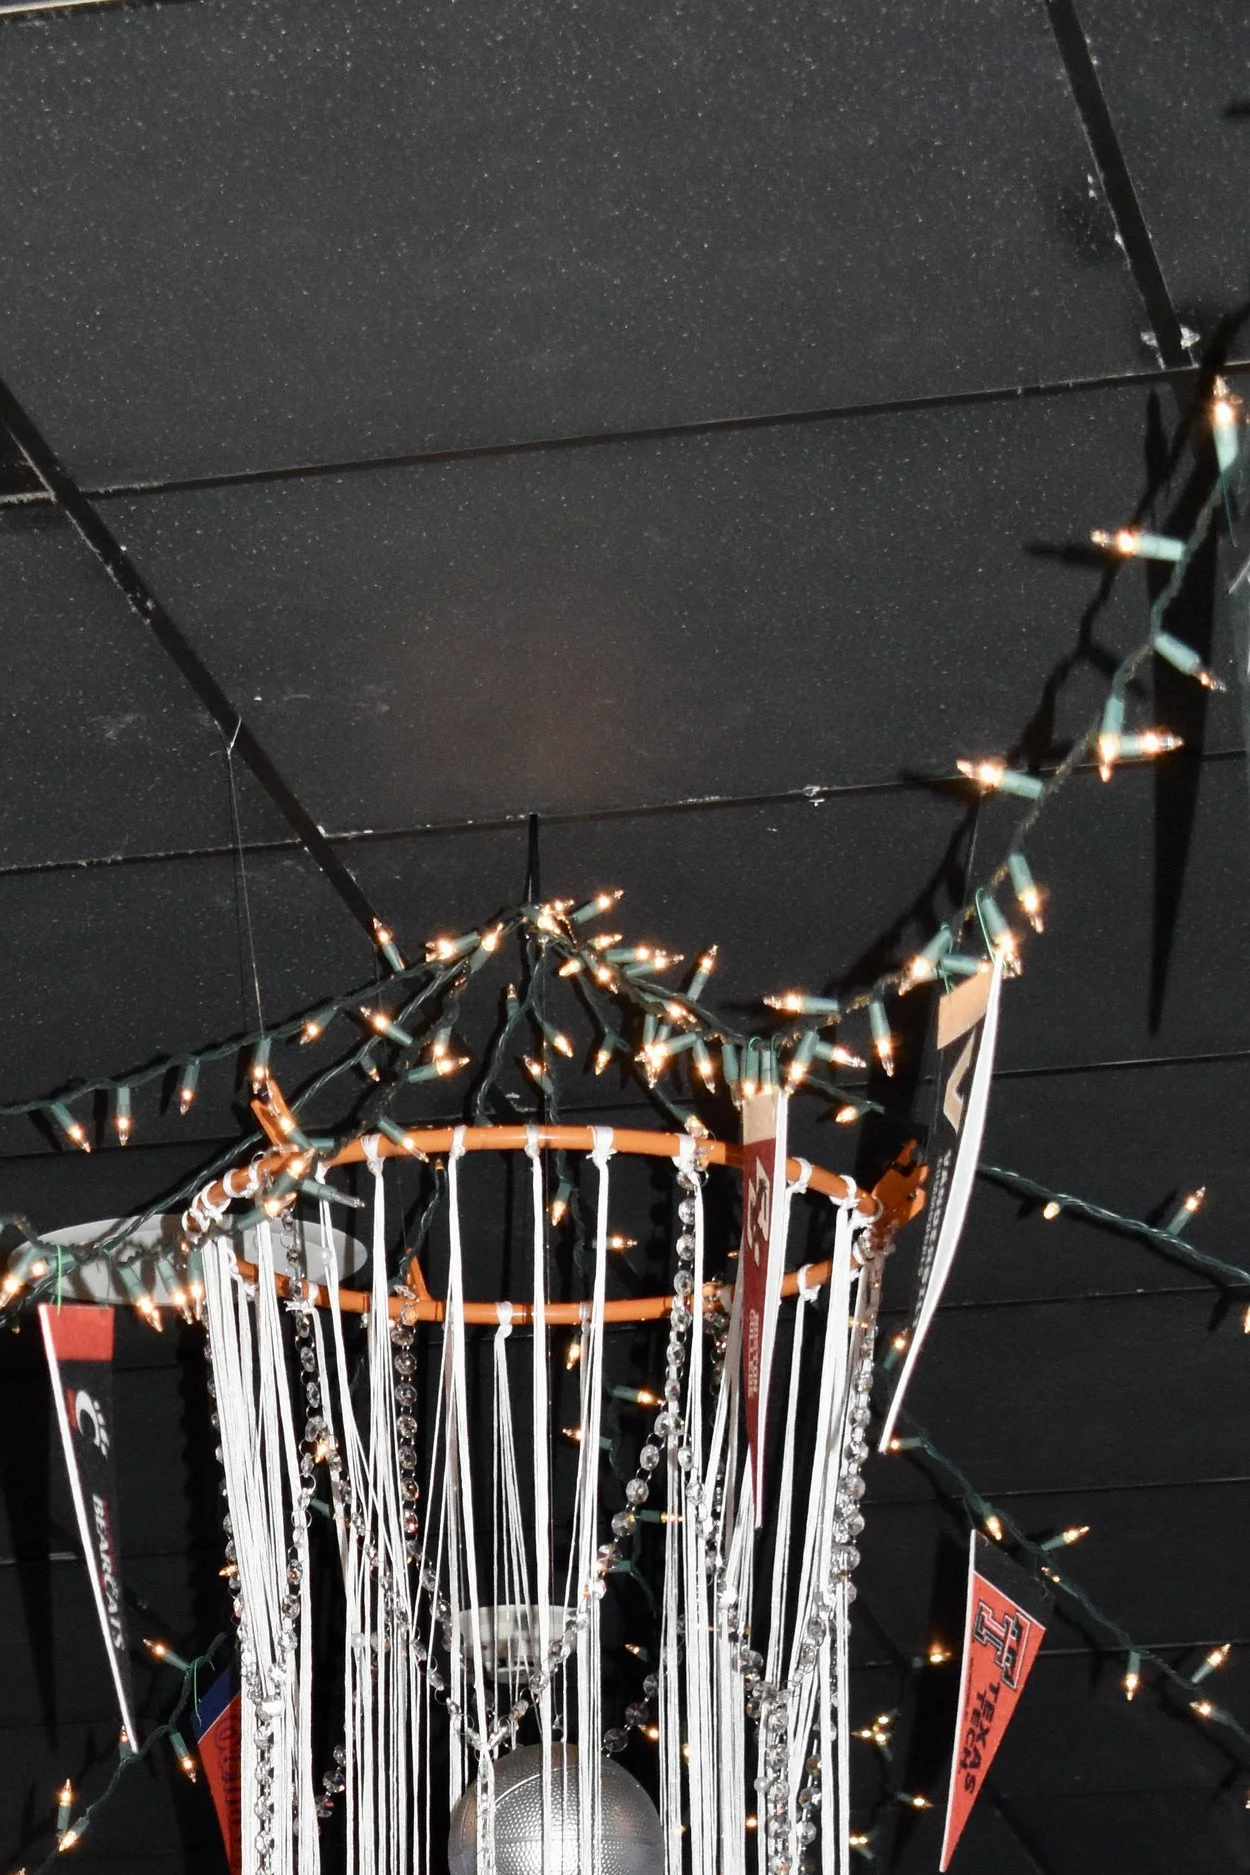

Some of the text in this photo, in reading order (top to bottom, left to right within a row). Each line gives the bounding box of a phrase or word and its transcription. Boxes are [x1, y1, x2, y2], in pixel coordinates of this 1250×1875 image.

[92, 1493, 126, 1651] BEARCATS
[959, 1689, 989, 1770] TECH
[964, 1682, 1001, 1794] TEXAS
